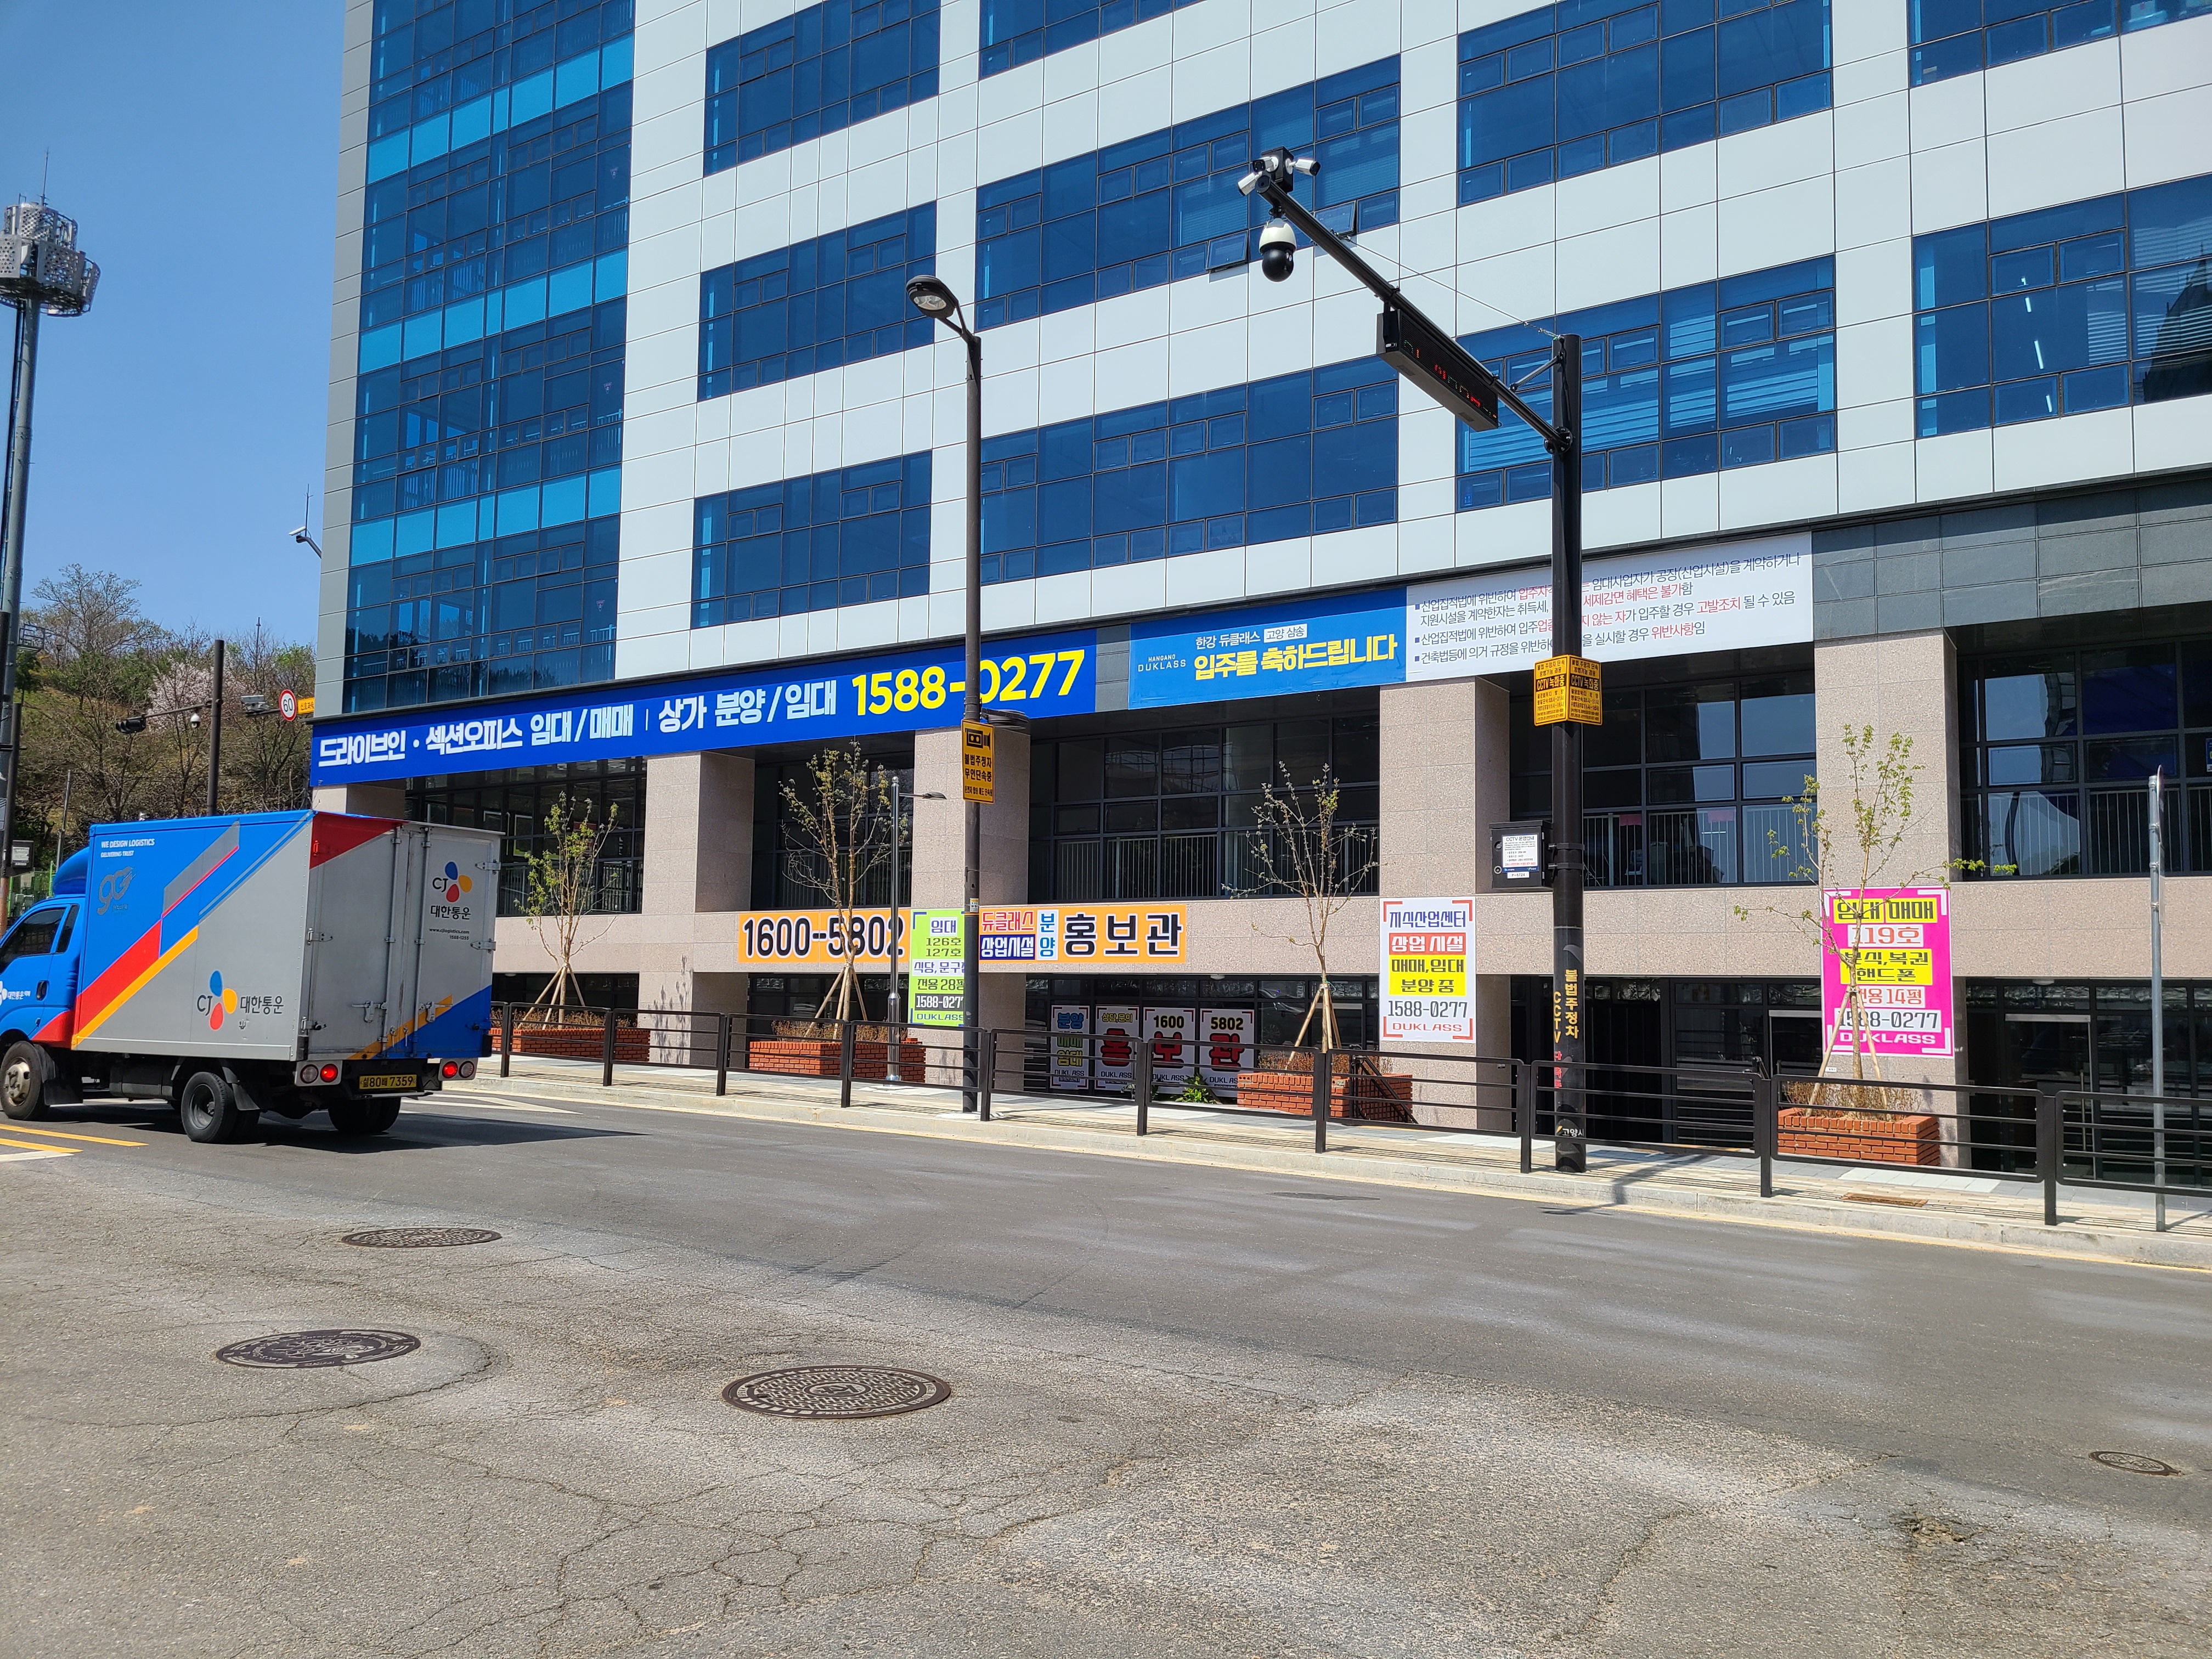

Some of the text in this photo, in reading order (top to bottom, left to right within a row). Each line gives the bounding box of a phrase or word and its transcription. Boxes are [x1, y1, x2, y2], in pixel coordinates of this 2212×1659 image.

[1421, 594, 1476, 612] 산업집적법에
[1593, 571, 1654, 591] 임대사업자가
[1656, 560, 1741, 582] 공장(산업시설)을
[1743, 552, 1801, 571] 계약하거나
[1420, 582, 1694, 627] 지원시설을 계약한자는 취득세, 세제감면 혜택은 불가함
[1421, 628, 1476, 645] 산업집적법에
[1478, 623, 1516, 639] 위반하여
[1592, 613, 1613, 626] 않는
[1615, 608, 1637, 623] 자가
[1639, 605, 1671, 620] 입주할
[1673, 602, 1695, 617] 경우
[1697, 596, 1740, 614] 고발조치
[1743, 595, 1755, 609] 될
[1757, 594, 1770, 608] 수
[1772, 591, 1796, 606] 있음
[1195, 627, 1305, 650] 한강 듀클래스 고양 삼송
[1421, 648, 1466, 664] 건축법등에
[1469, 645, 1487, 659] 의거
[1490, 642, 1519, 657] 규정을
[1521, 639, 1553, 654] 위반하
[1595, 630, 1626, 646] 실시할
[1628, 628, 1650, 642] 경우
[1651, 621, 1705, 640] 위반사항임
[1138, 659, 1186, 672] DUKLASS
[1148, 654, 1176, 663] HANGANG
[1194, 634, 1398, 681] 입주를 축하드립니다
[283, 698, 293, 712] 60
[318, 730, 406, 767] 드라이브인
[426, 721, 523, 755] 섹션오피스
[659, 696, 707, 733] 상가
[852, 649, 1085, 716] 1588-0277
[965, 768, 992, 782] 무인단속중
[110, 840, 128, 848] DESIGN
[129, 838, 155, 847] LOGISTICS
[432, 877, 449, 893] CJ
[430, 905, 471, 919] 대한통운
[1837, 901, 1934, 919] 임대 매매
[931, 920, 956, 933] 임대
[982, 911, 1034, 932] 듀클래스
[1390, 911, 1466, 928] 지식산업센터
[744, 916, 904, 956] 1600-5802
[926, 937, 961, 946] 126호
[1064, 913, 1182, 956] 홍보관
[981, 936, 1034, 957] 상업시설
[1391, 935, 1463, 952] 상업 시설
[926, 948, 961, 957] 127호
[1391, 959, 1464, 973] 매매,임대
[1855, 968, 1916, 982] 핸드폰
[917, 979, 938, 990] 전용
[1401, 979, 1454, 993] 분양 중
[197, 995, 284, 1016] CJ 대한통운
[1565, 969, 1579, 1039] 불법주정차
[1886, 989, 1922, 1005] 14평
[1388, 1000, 1468, 1018] 1588-0277
[1553, 991, 1562, 1043] CCTV
[1057, 1012, 1084, 1029] 분양
[1102, 1013, 1133, 1023] 상담,문의
[1154, 1015, 1244, 1030] 1600 5802
[1837, 1011, 1938, 1029] 1588-0277
[1392, 1023, 1463, 1032] DUKLASS
[1057, 1049, 1083, 1067] 임대
[1101, 1028, 1132, 1067] 홍
[1209, 1032, 1245, 1072] 관
[390, 1076, 414, 1087] 7359
[1562, 1128, 1584, 1137] 고양시
